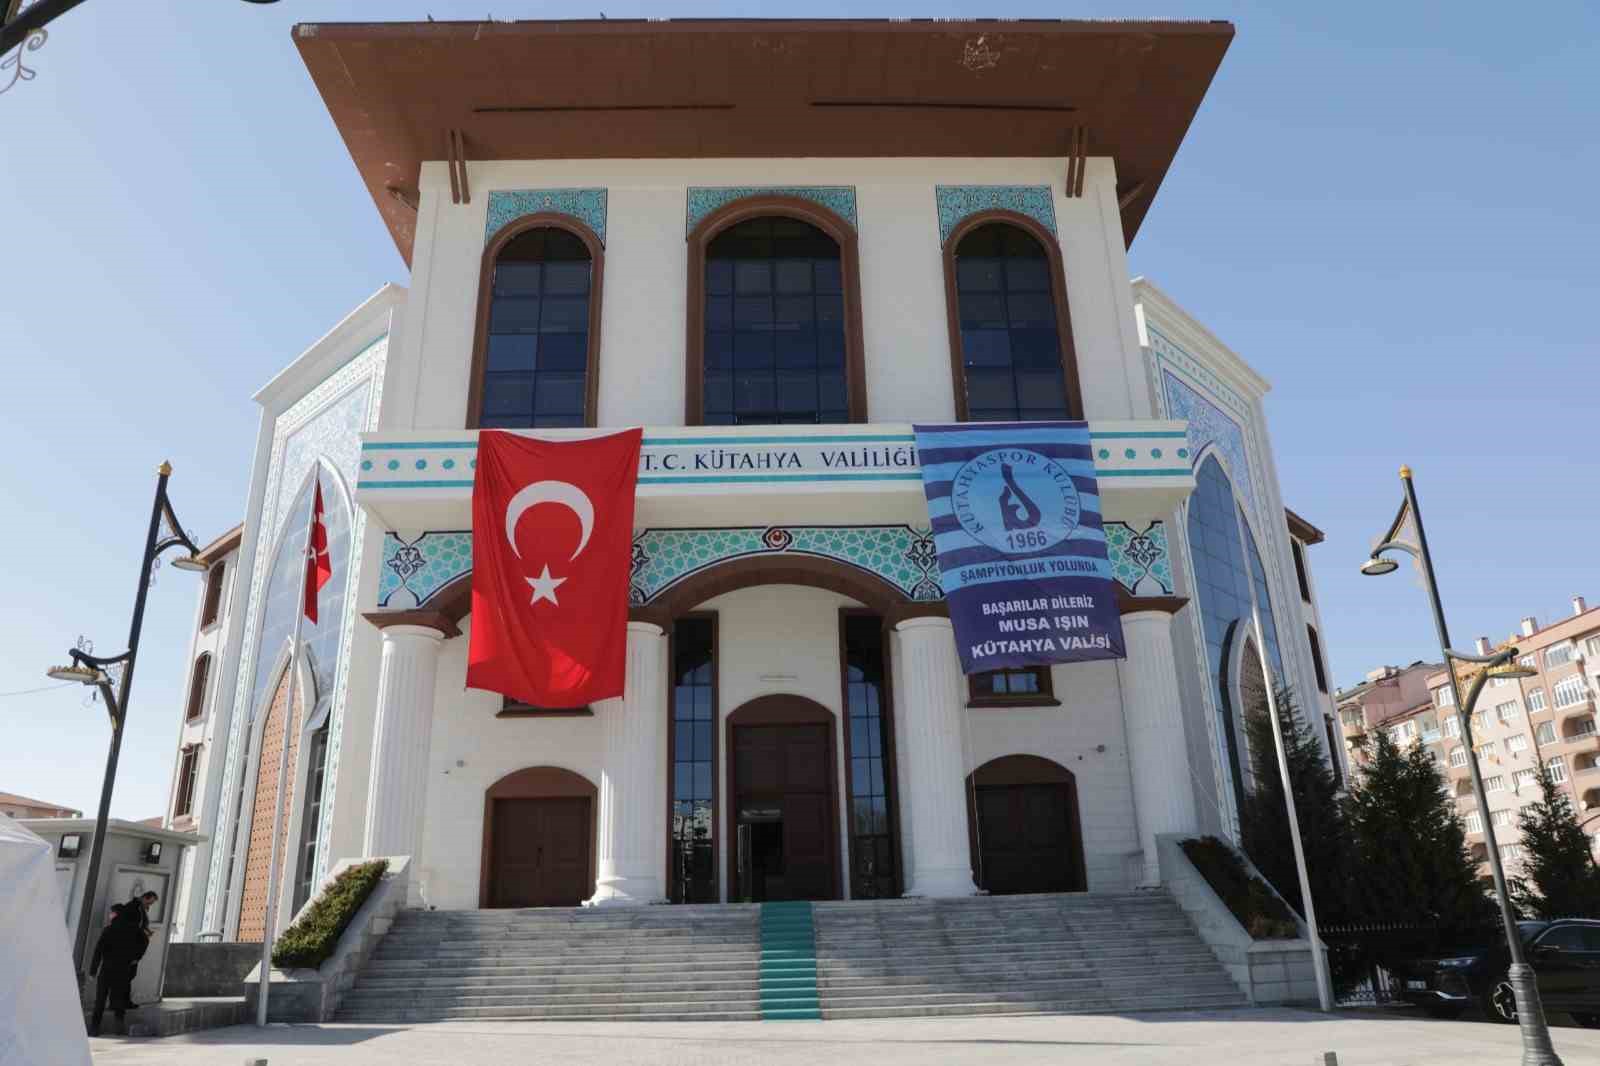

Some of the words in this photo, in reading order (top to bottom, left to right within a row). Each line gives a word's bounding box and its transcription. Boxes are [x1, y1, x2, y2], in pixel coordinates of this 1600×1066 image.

[640, 454, 689, 470] T.C.
[695, 449, 802, 470] KÜTAHYA
[820, 447, 916, 468] VALİLİĞİ
[1006, 530, 1047, 551] 1966
[960, 560, 1046, 583] ŞAMPİYONLUK
[1049, 559, 1099, 573] YOLUNDA
[982, 598, 1049, 616] BAŞARILAR
[1052, 594, 1095, 609] DİLERİZ
[998, 617, 1050, 633] MUSA
[1054, 615, 1089, 631] IŞIN
[971, 637, 1057, 659] KÜTAHYA
[1059, 633, 1111, 650] VALİSİ
